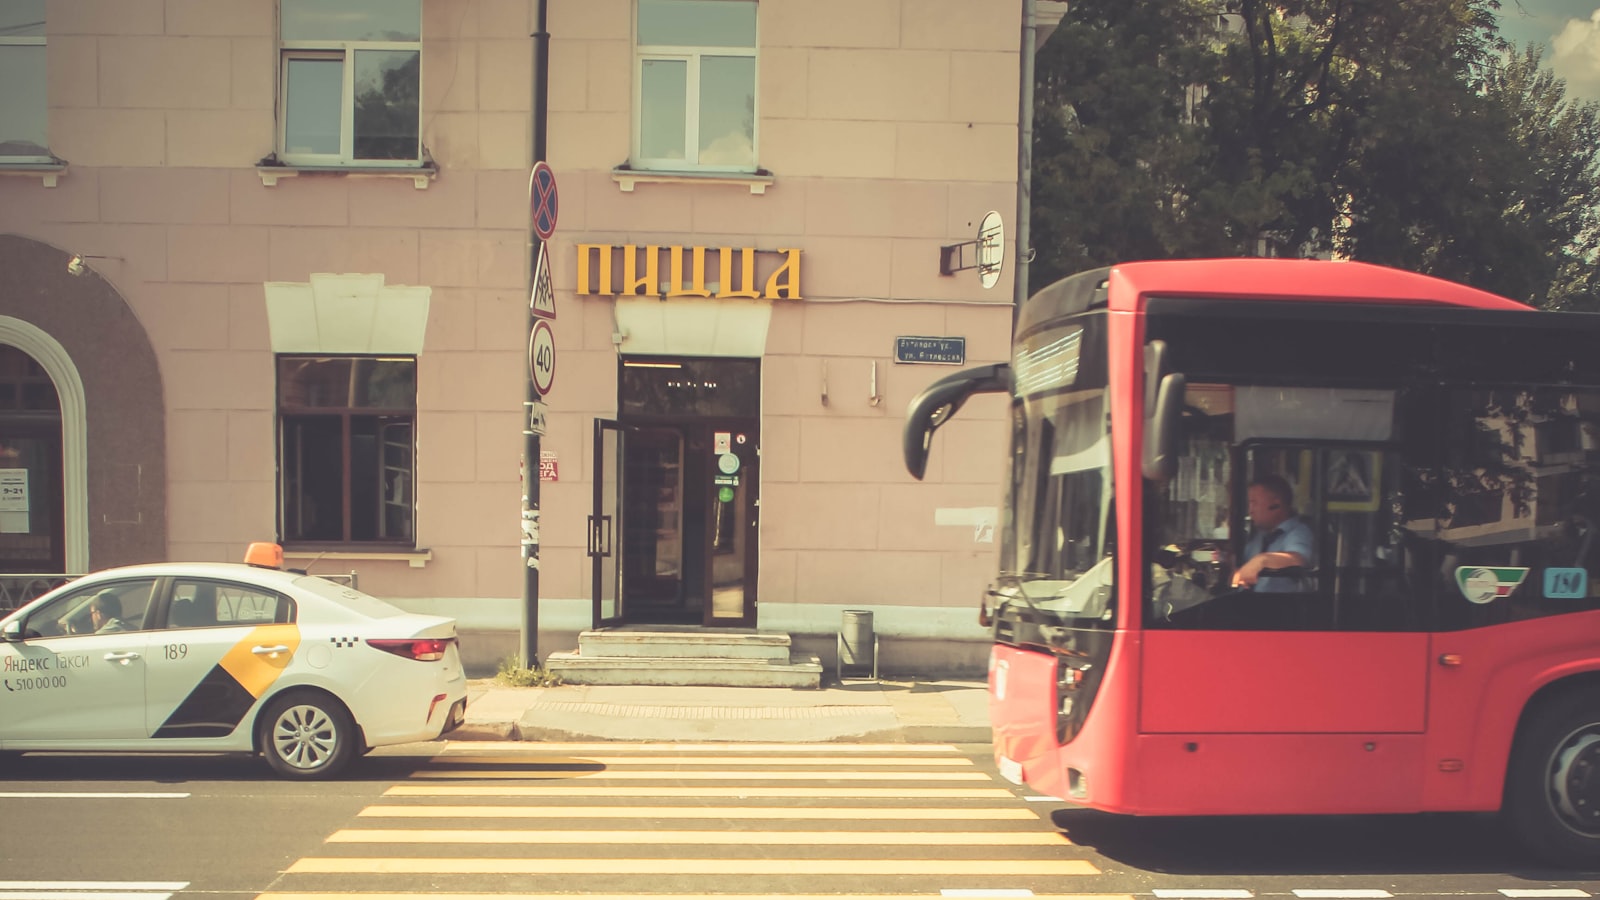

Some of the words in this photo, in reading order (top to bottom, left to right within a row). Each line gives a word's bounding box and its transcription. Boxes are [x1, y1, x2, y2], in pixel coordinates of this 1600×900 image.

[576, 243, 803, 299] ПИЦЦА
[536, 344, 551, 373] 40
[163, 643, 188, 660] 189
[4, 655, 49, 673] Яндекс
[54, 652, 90, 669] Такси
[16, 678, 34, 691] 510
[36, 677, 50, 690] 00
[52, 675, 67, 688] 00
